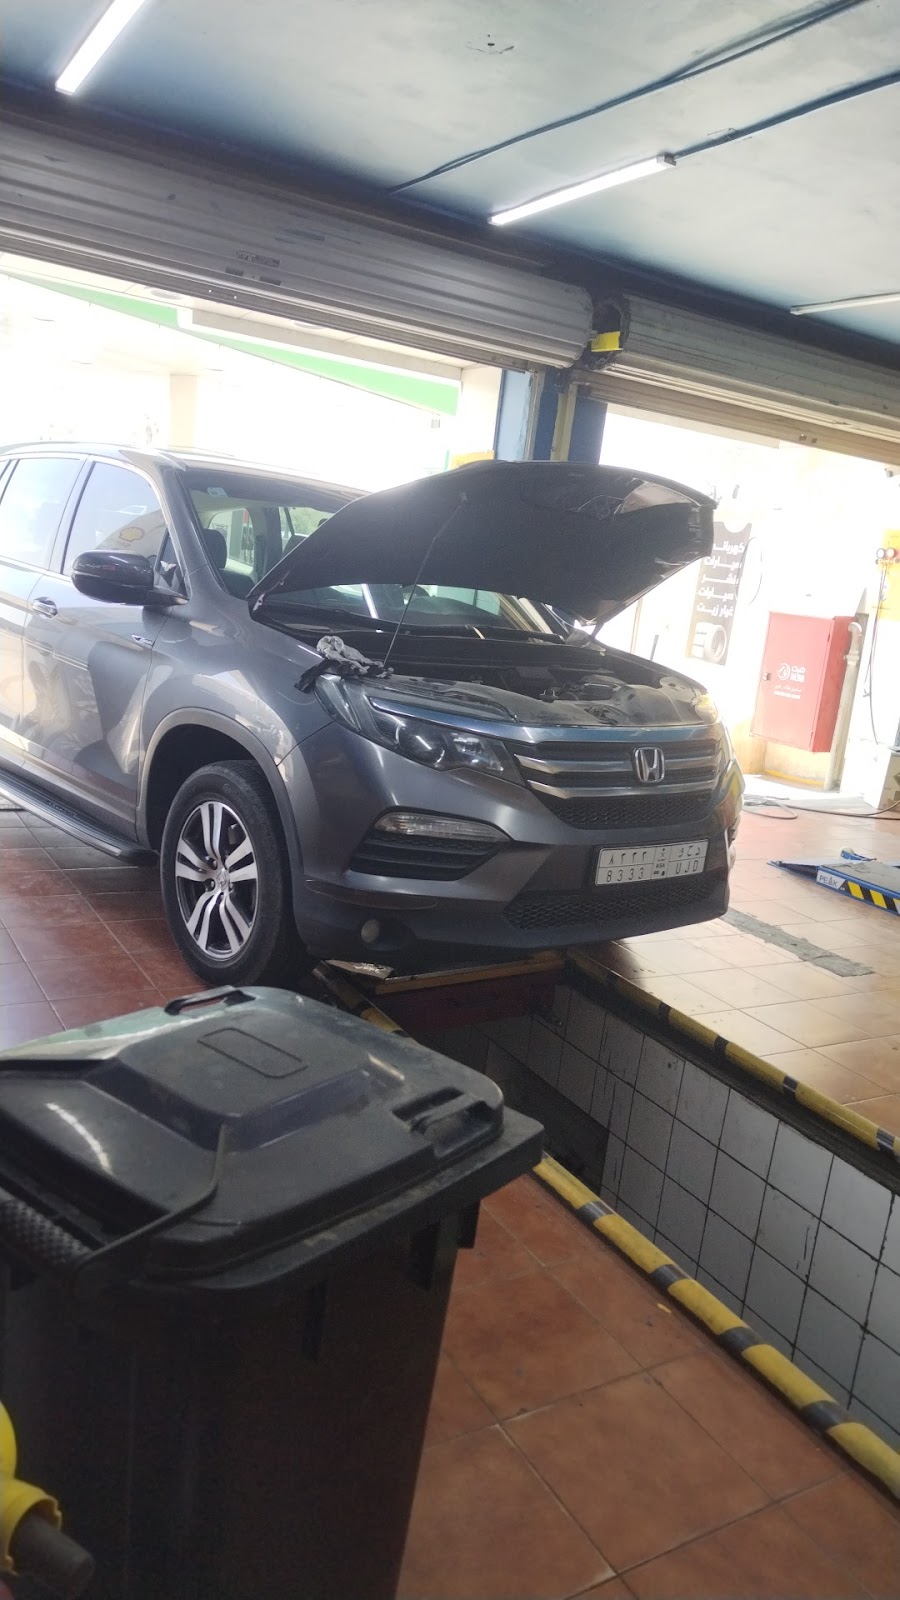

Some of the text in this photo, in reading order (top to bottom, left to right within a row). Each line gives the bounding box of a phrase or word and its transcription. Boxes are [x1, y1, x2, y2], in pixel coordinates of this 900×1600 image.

[697, 586, 734, 602] سيارات
[697, 602, 734, 618] غيار زيت
[606, 860, 698, 882] 8333 UJD
[819, 874, 838, 887] PEAK
